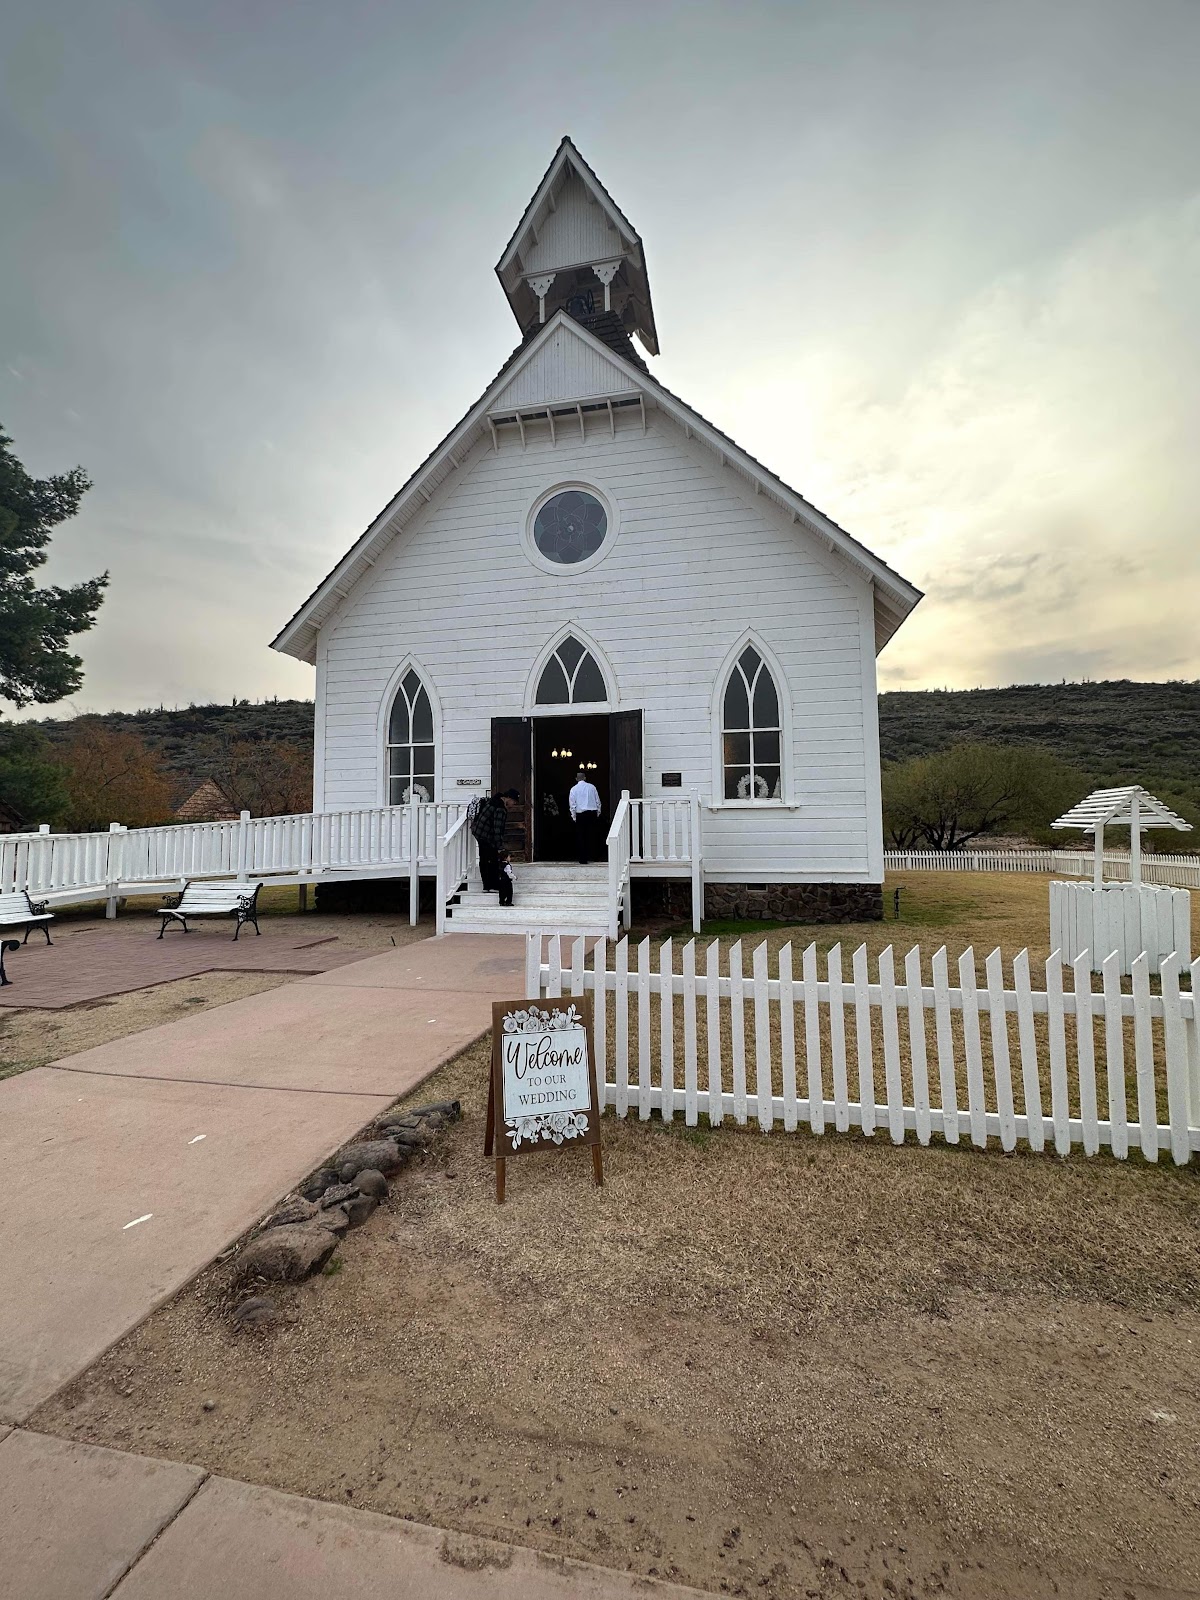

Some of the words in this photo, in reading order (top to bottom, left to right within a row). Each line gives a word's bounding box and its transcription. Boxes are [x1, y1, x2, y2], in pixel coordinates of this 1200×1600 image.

[507, 1035, 583, 1079] Welcome
[527, 1077, 542, 1087] TO
[544, 1074, 567, 1086] OUR
[518, 1089, 577, 1106] WEDDING
